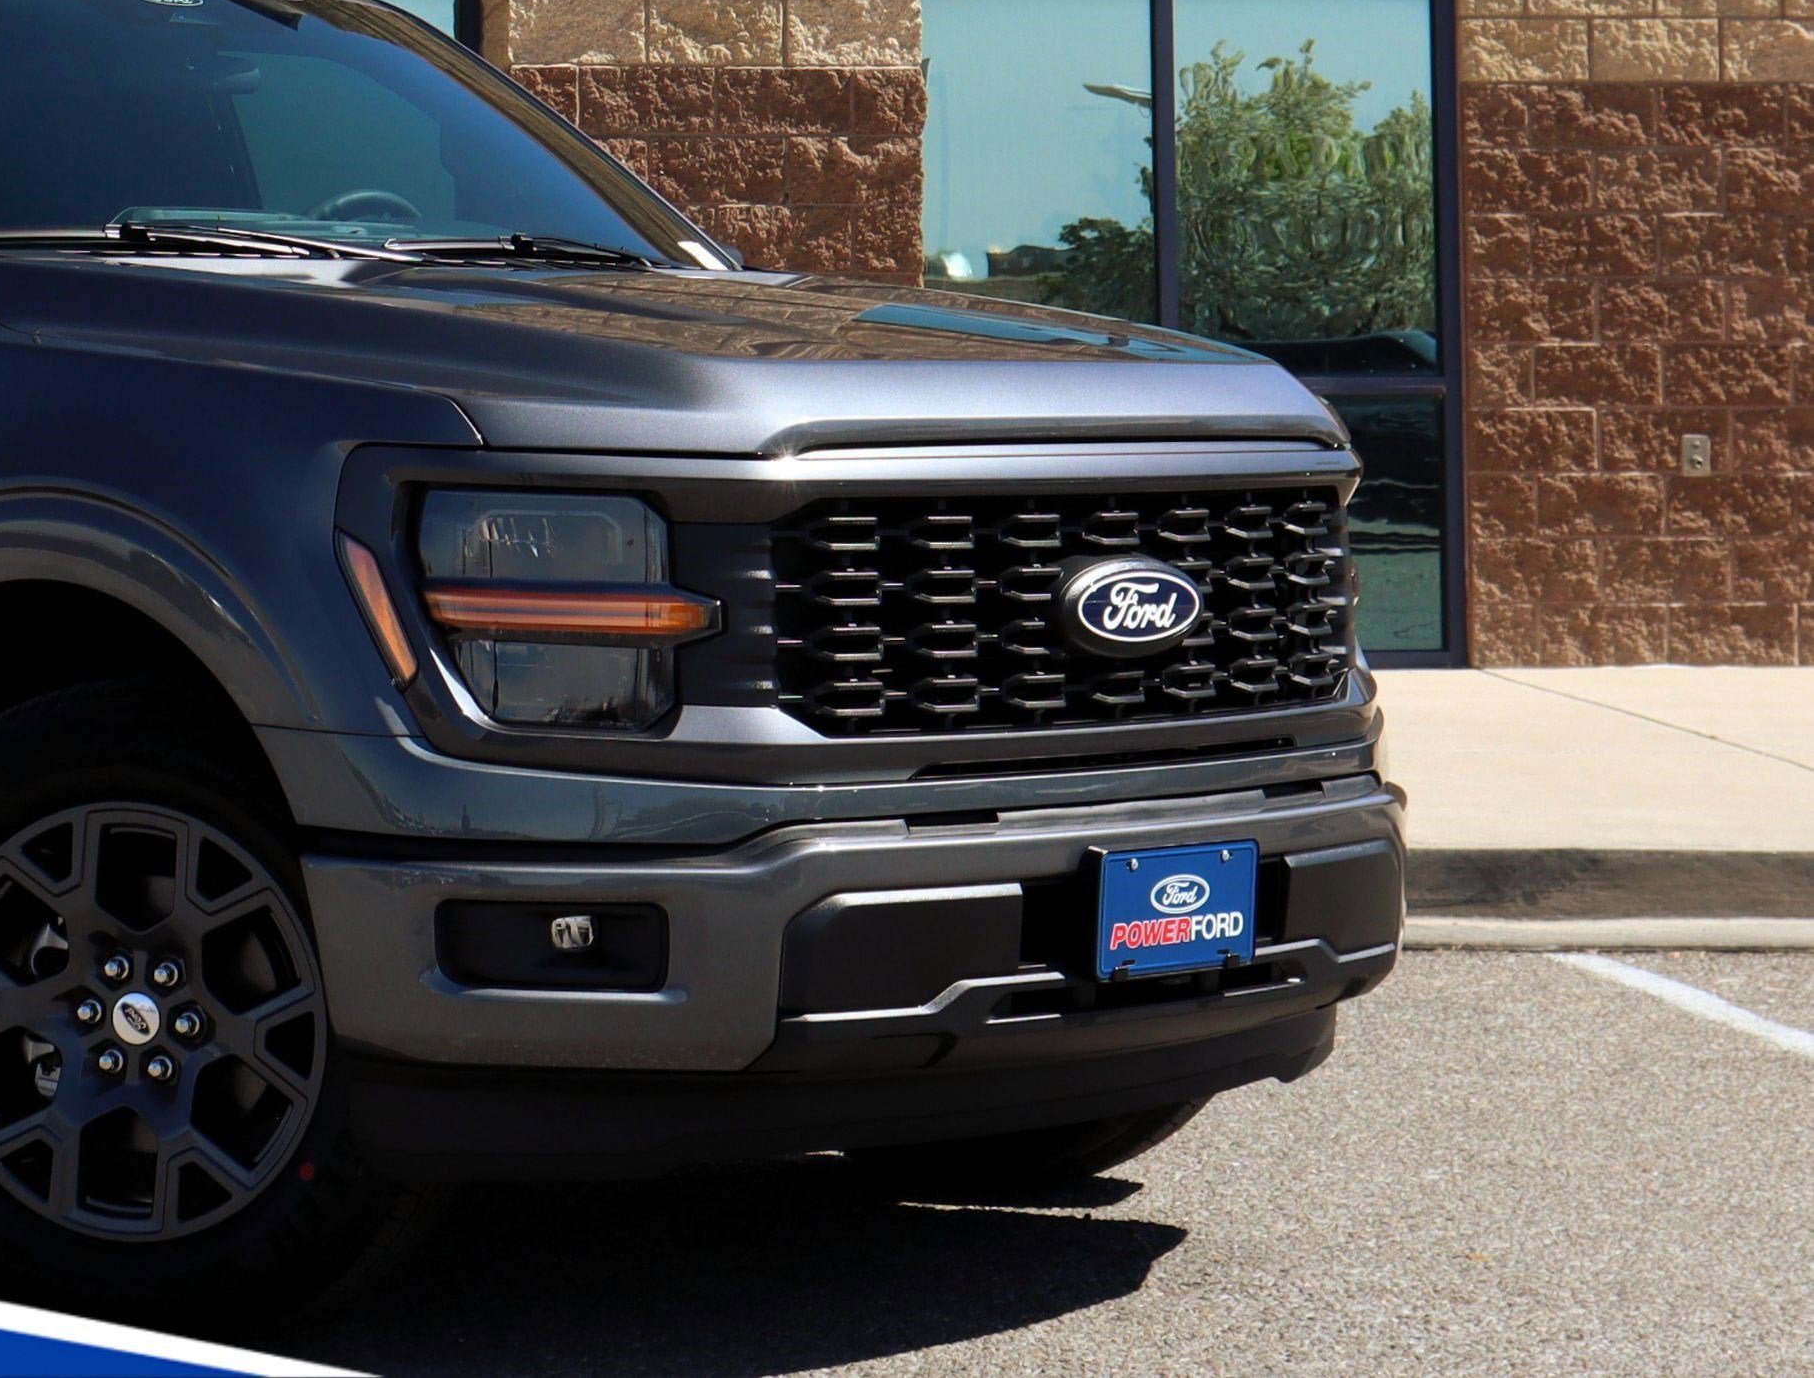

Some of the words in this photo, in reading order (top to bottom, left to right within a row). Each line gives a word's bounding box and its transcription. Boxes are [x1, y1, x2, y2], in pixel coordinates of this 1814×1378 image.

[1103, 582, 1177, 630] Ford
[1162, 882, 1198, 906] Ford
[1110, 911, 1244, 950] POWERFORD
